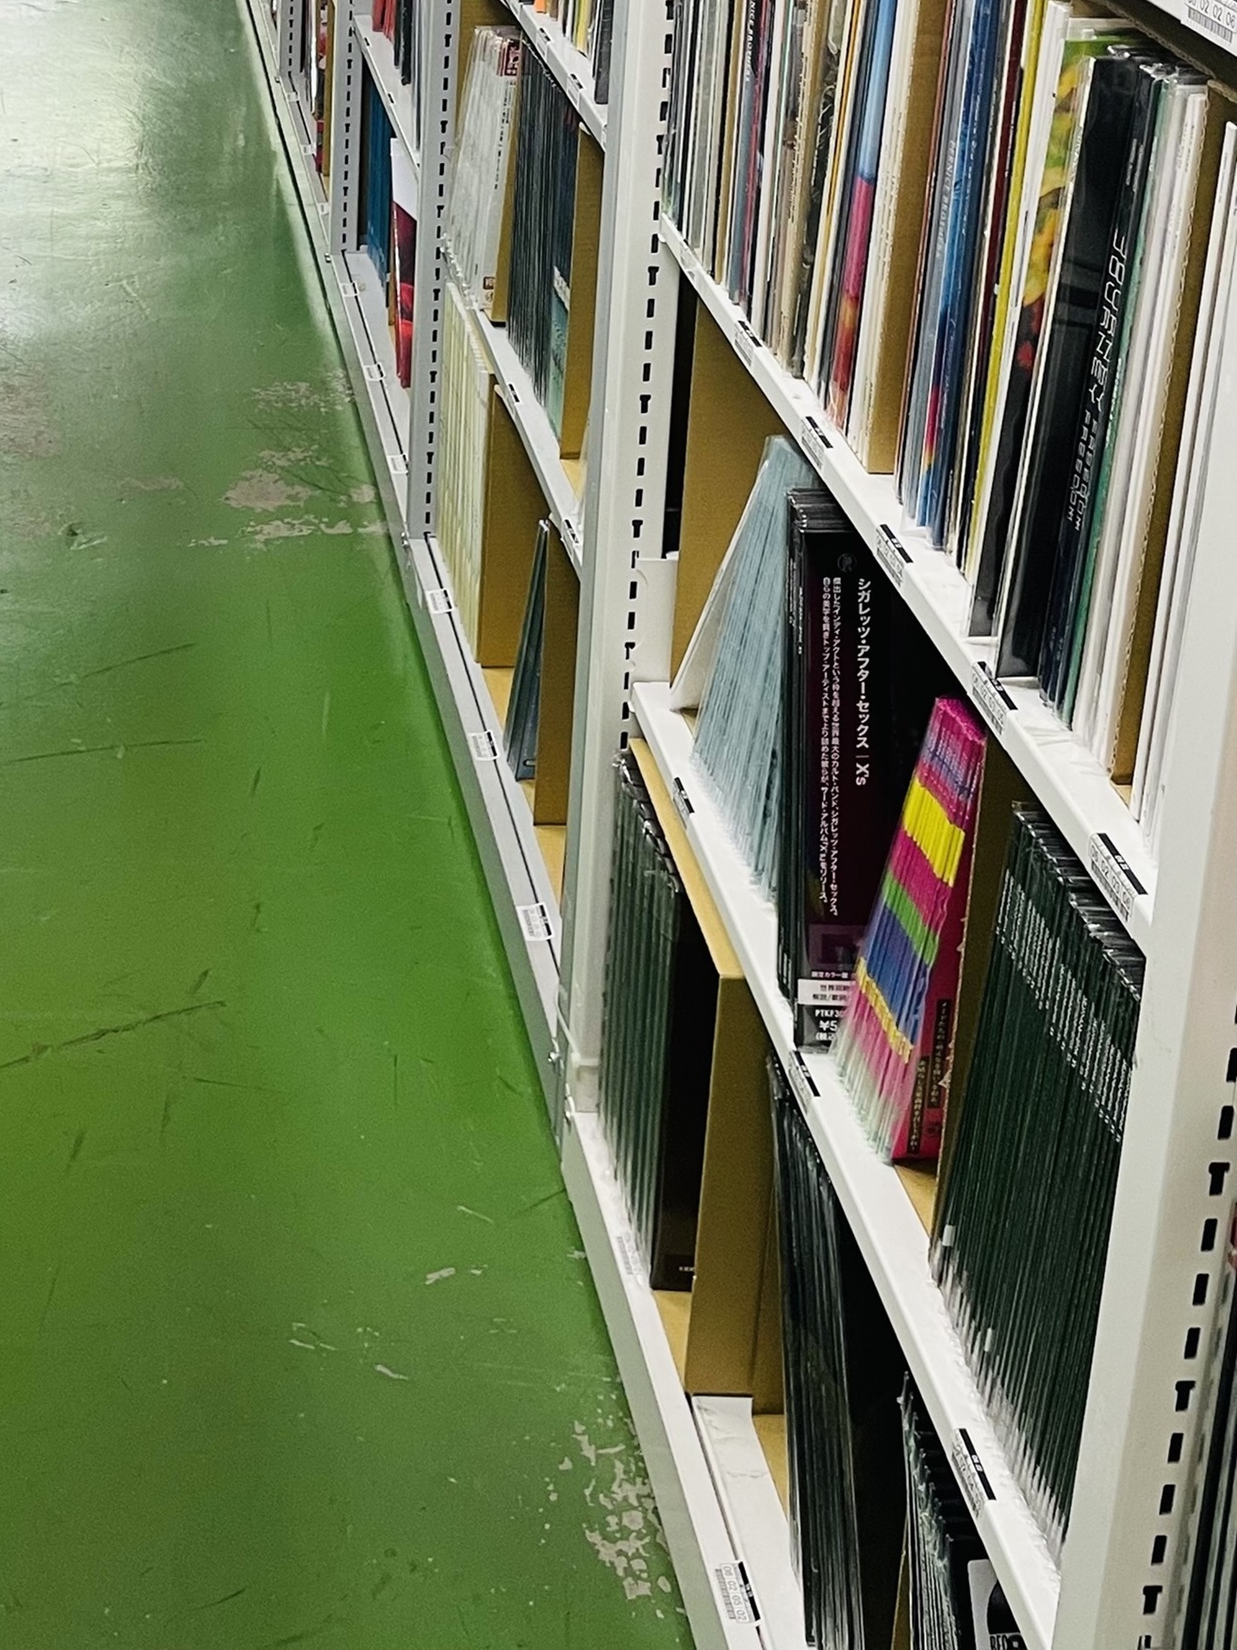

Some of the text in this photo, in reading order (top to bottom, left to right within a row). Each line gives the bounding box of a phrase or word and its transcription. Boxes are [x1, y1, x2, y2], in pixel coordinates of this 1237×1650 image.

[1212, 3, 1223, 22] 02
[855, 578, 871, 749] シガレッツ・アフター・セックス
